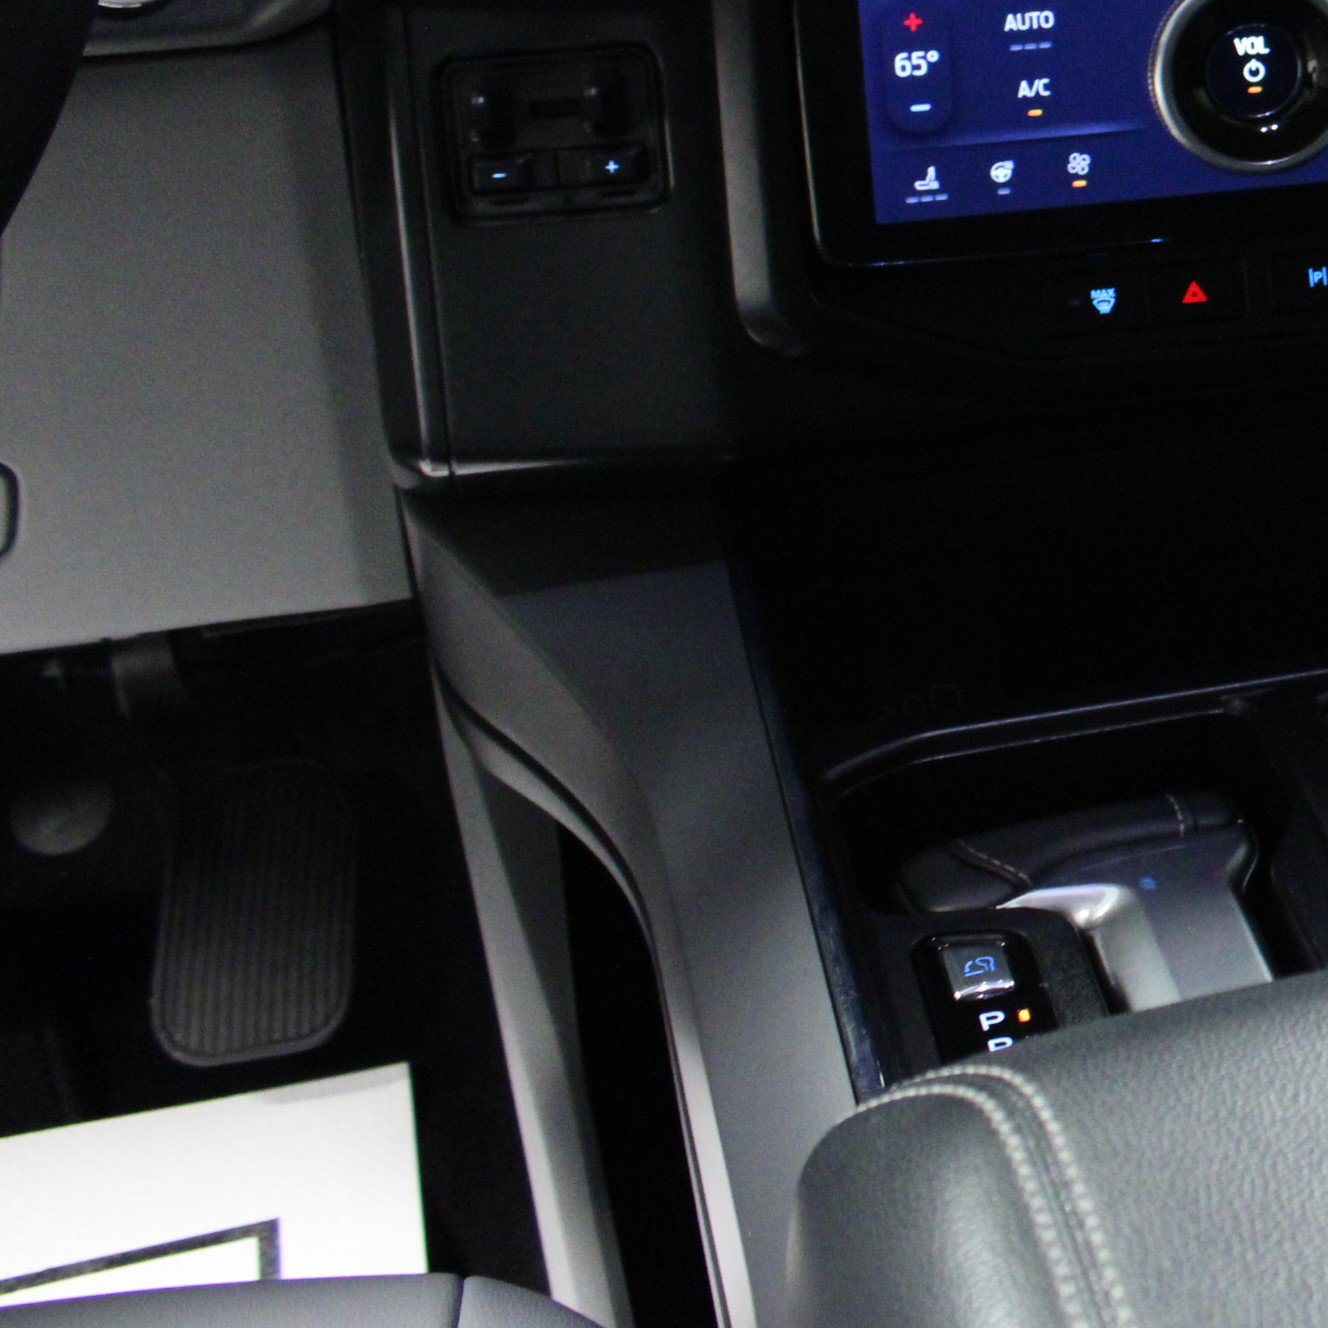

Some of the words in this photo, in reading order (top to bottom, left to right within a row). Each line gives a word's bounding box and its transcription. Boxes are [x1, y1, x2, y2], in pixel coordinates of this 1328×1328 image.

[1004, 10, 1055, 32] AUTO
[1233, 35, 1270, 56] VOL
[893, 50, 940, 78] 65°
[1017, 77, 1051, 99] A/C
[978, 1010, 1005, 1032] P
